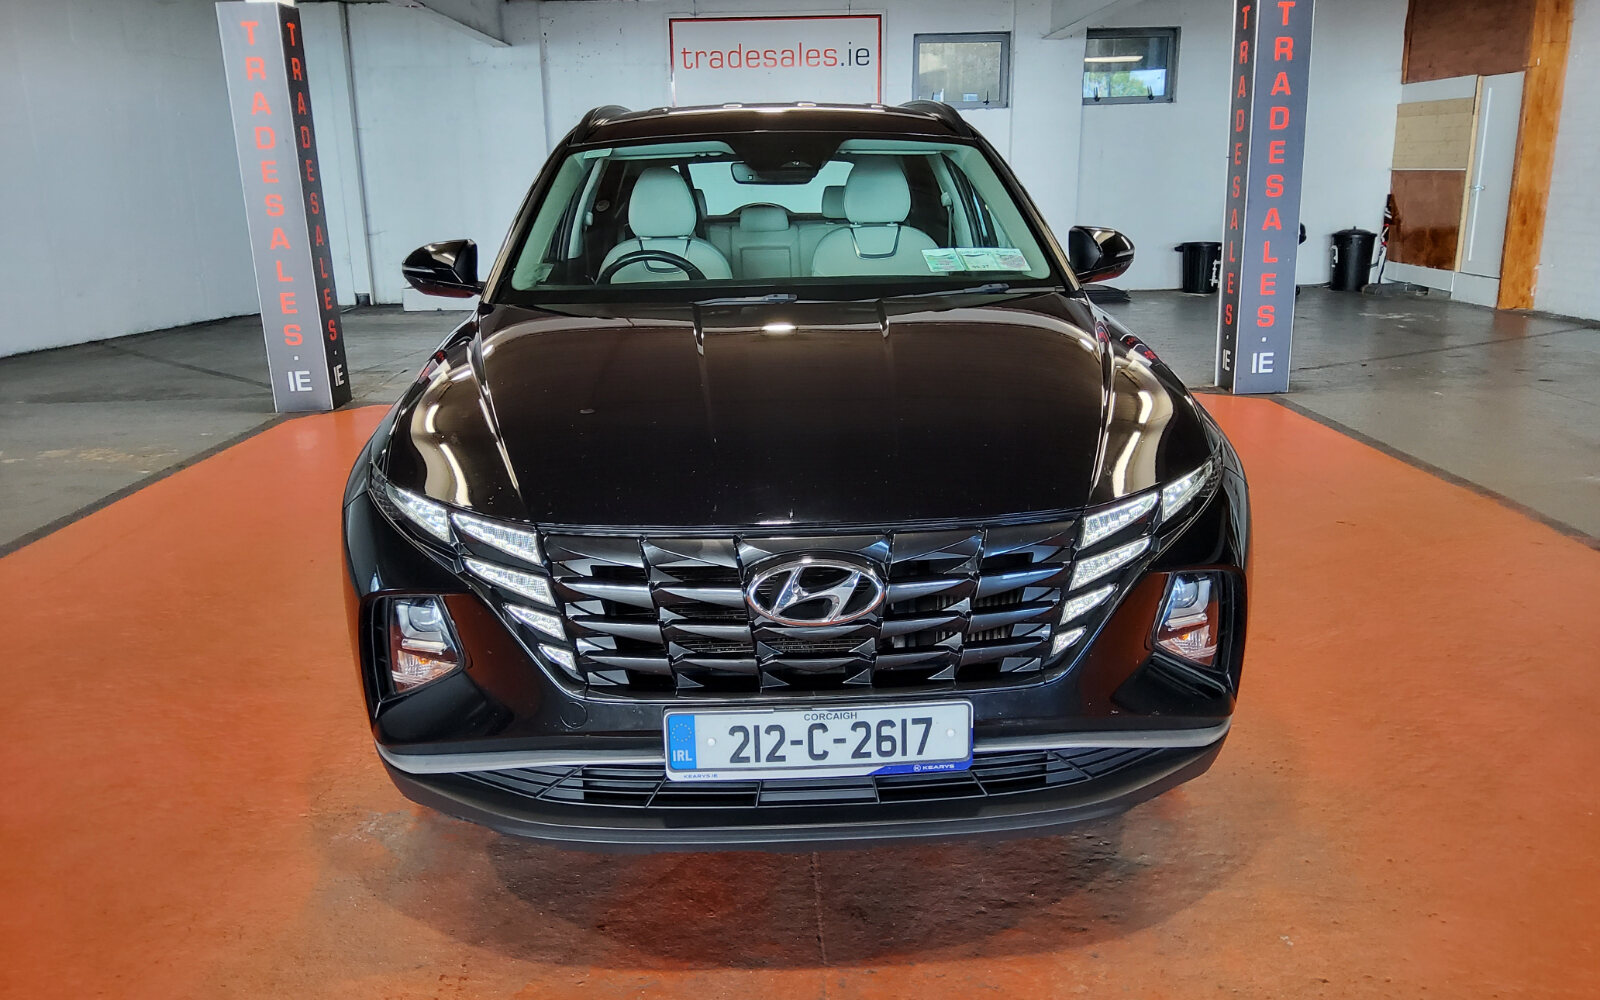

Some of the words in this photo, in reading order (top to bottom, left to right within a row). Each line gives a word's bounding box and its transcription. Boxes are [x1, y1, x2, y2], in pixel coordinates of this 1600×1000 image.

[681, 41, 870, 70] tradesales.ie
[803, 711, 858, 722] CORCAIGH
[728, 717, 933, 764] 212-C-2617
[672, 750, 693, 762] IRL
